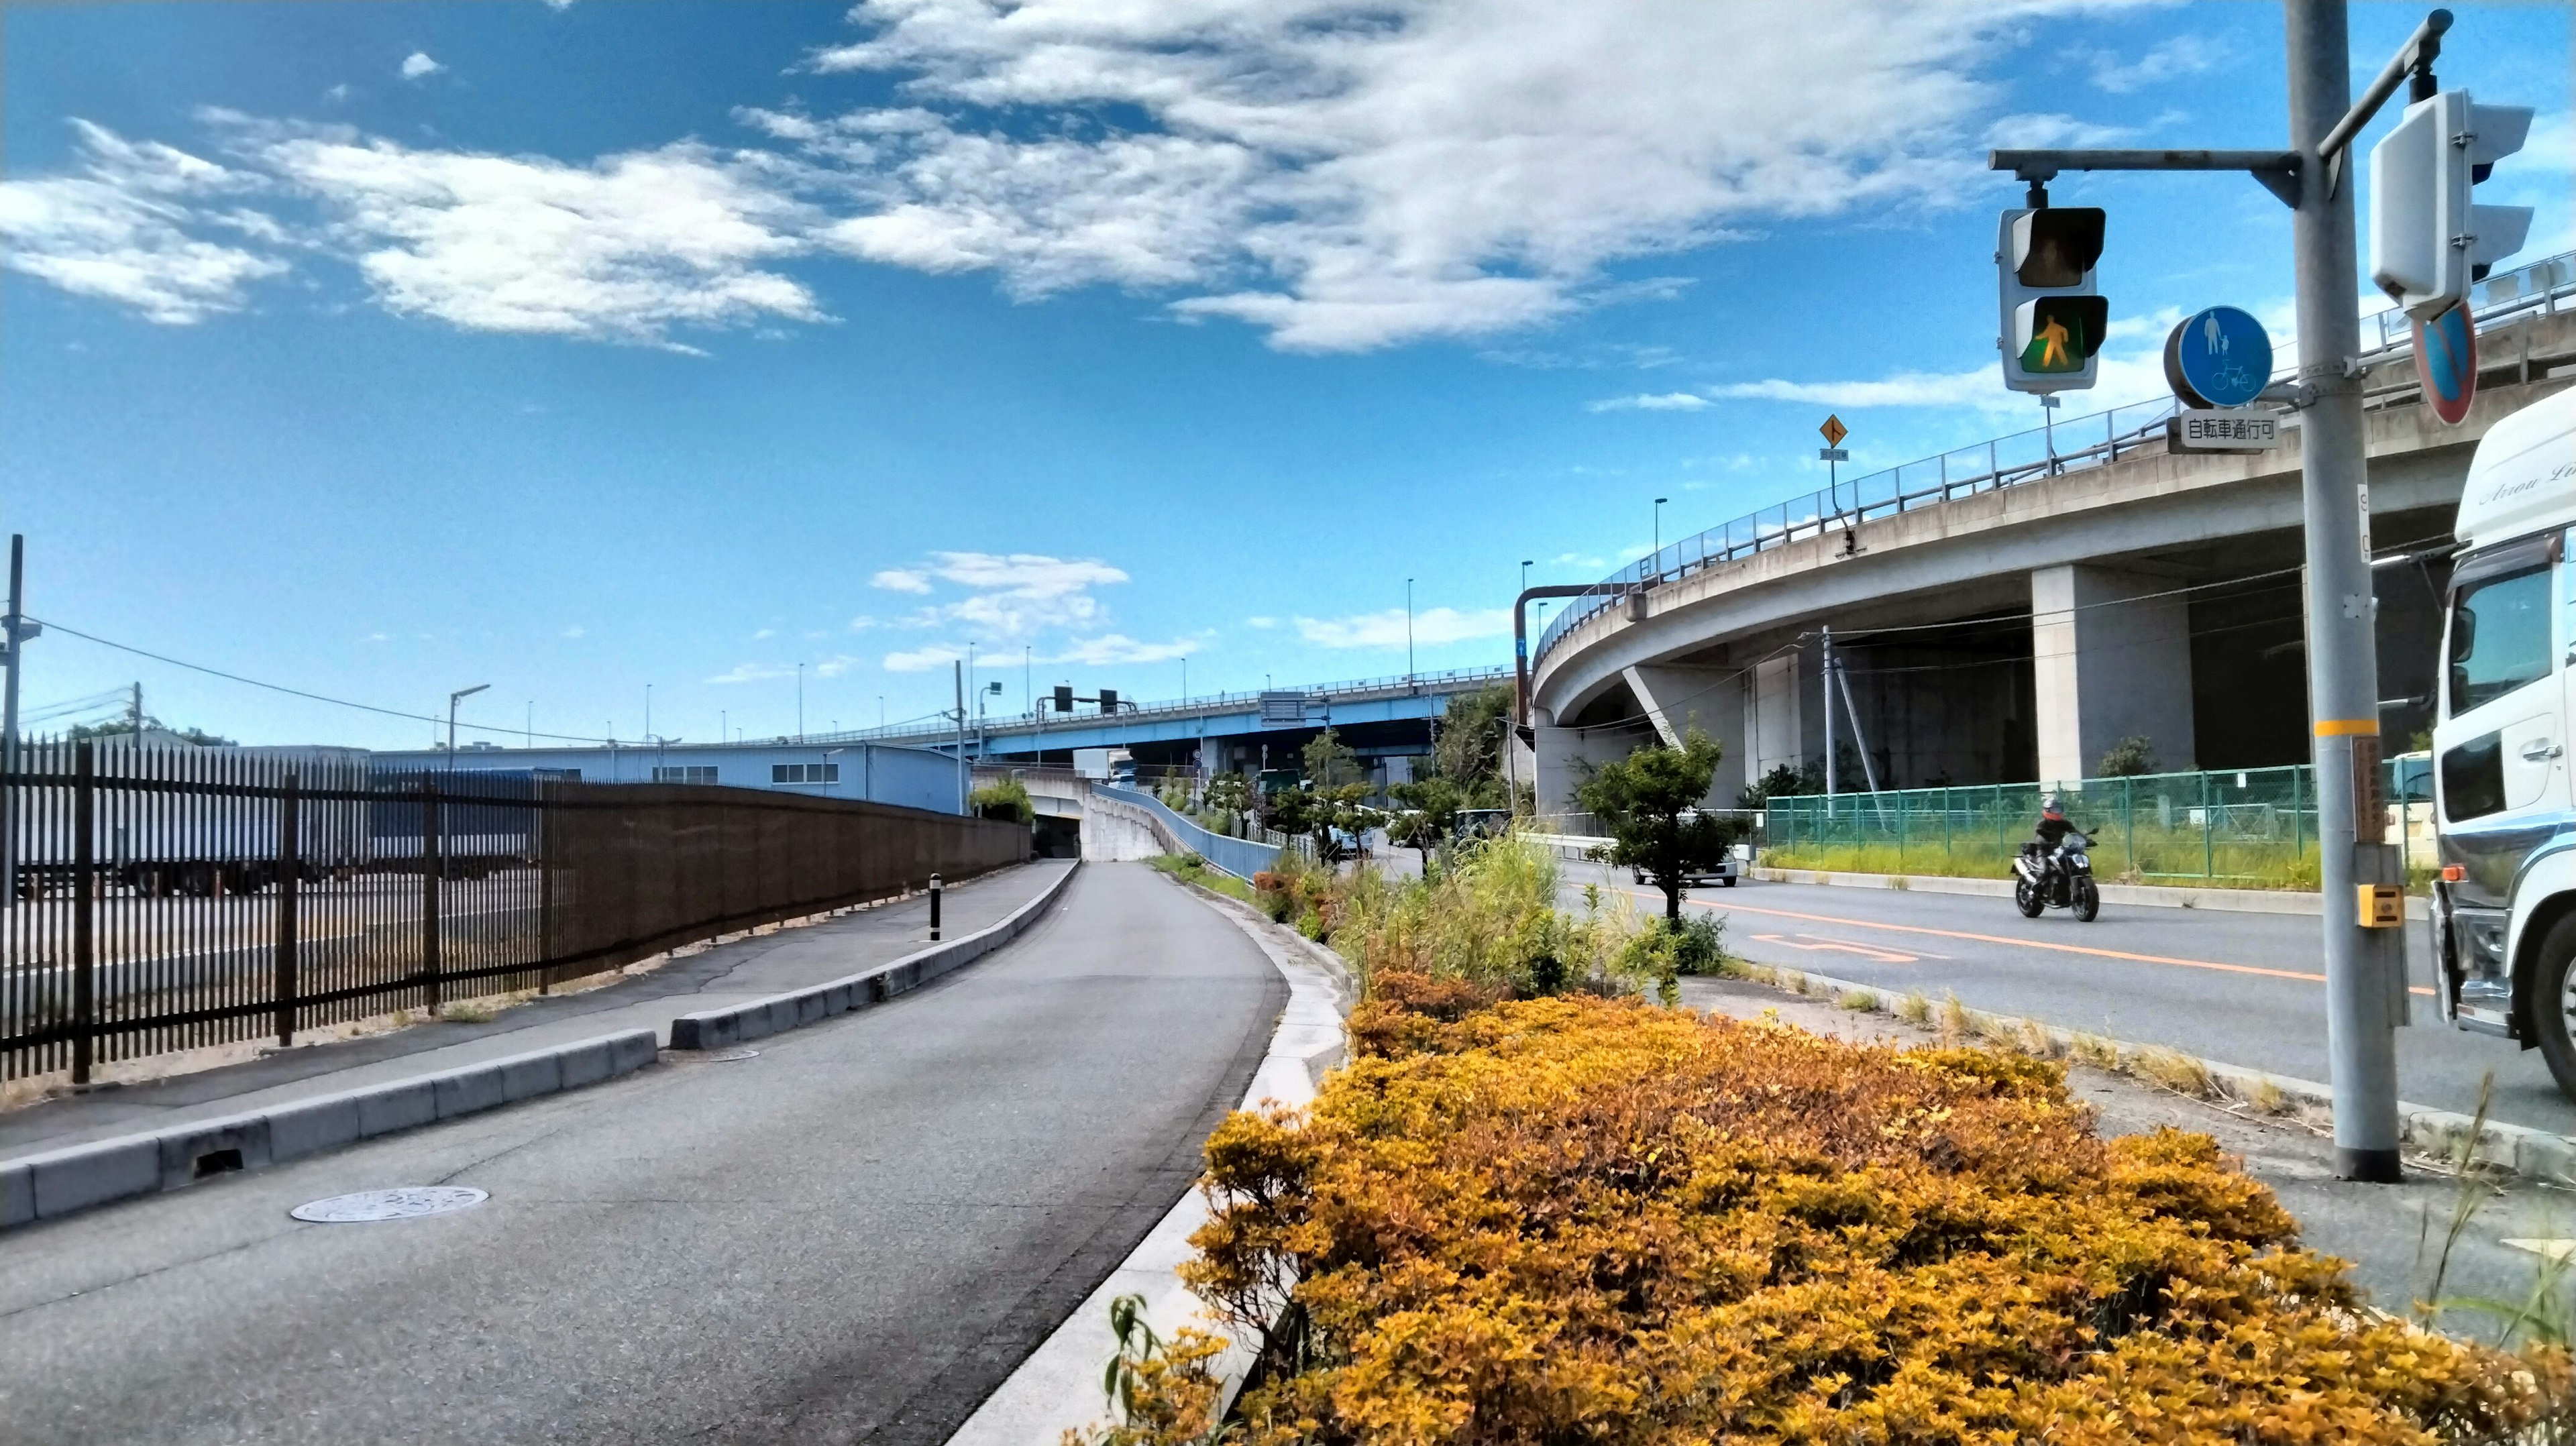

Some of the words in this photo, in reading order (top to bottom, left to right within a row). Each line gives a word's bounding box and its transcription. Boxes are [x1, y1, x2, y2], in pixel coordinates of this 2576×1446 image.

[2189, 418, 2274, 440] 自転車通行可
[2479, 478, 2541, 505] Arrow
